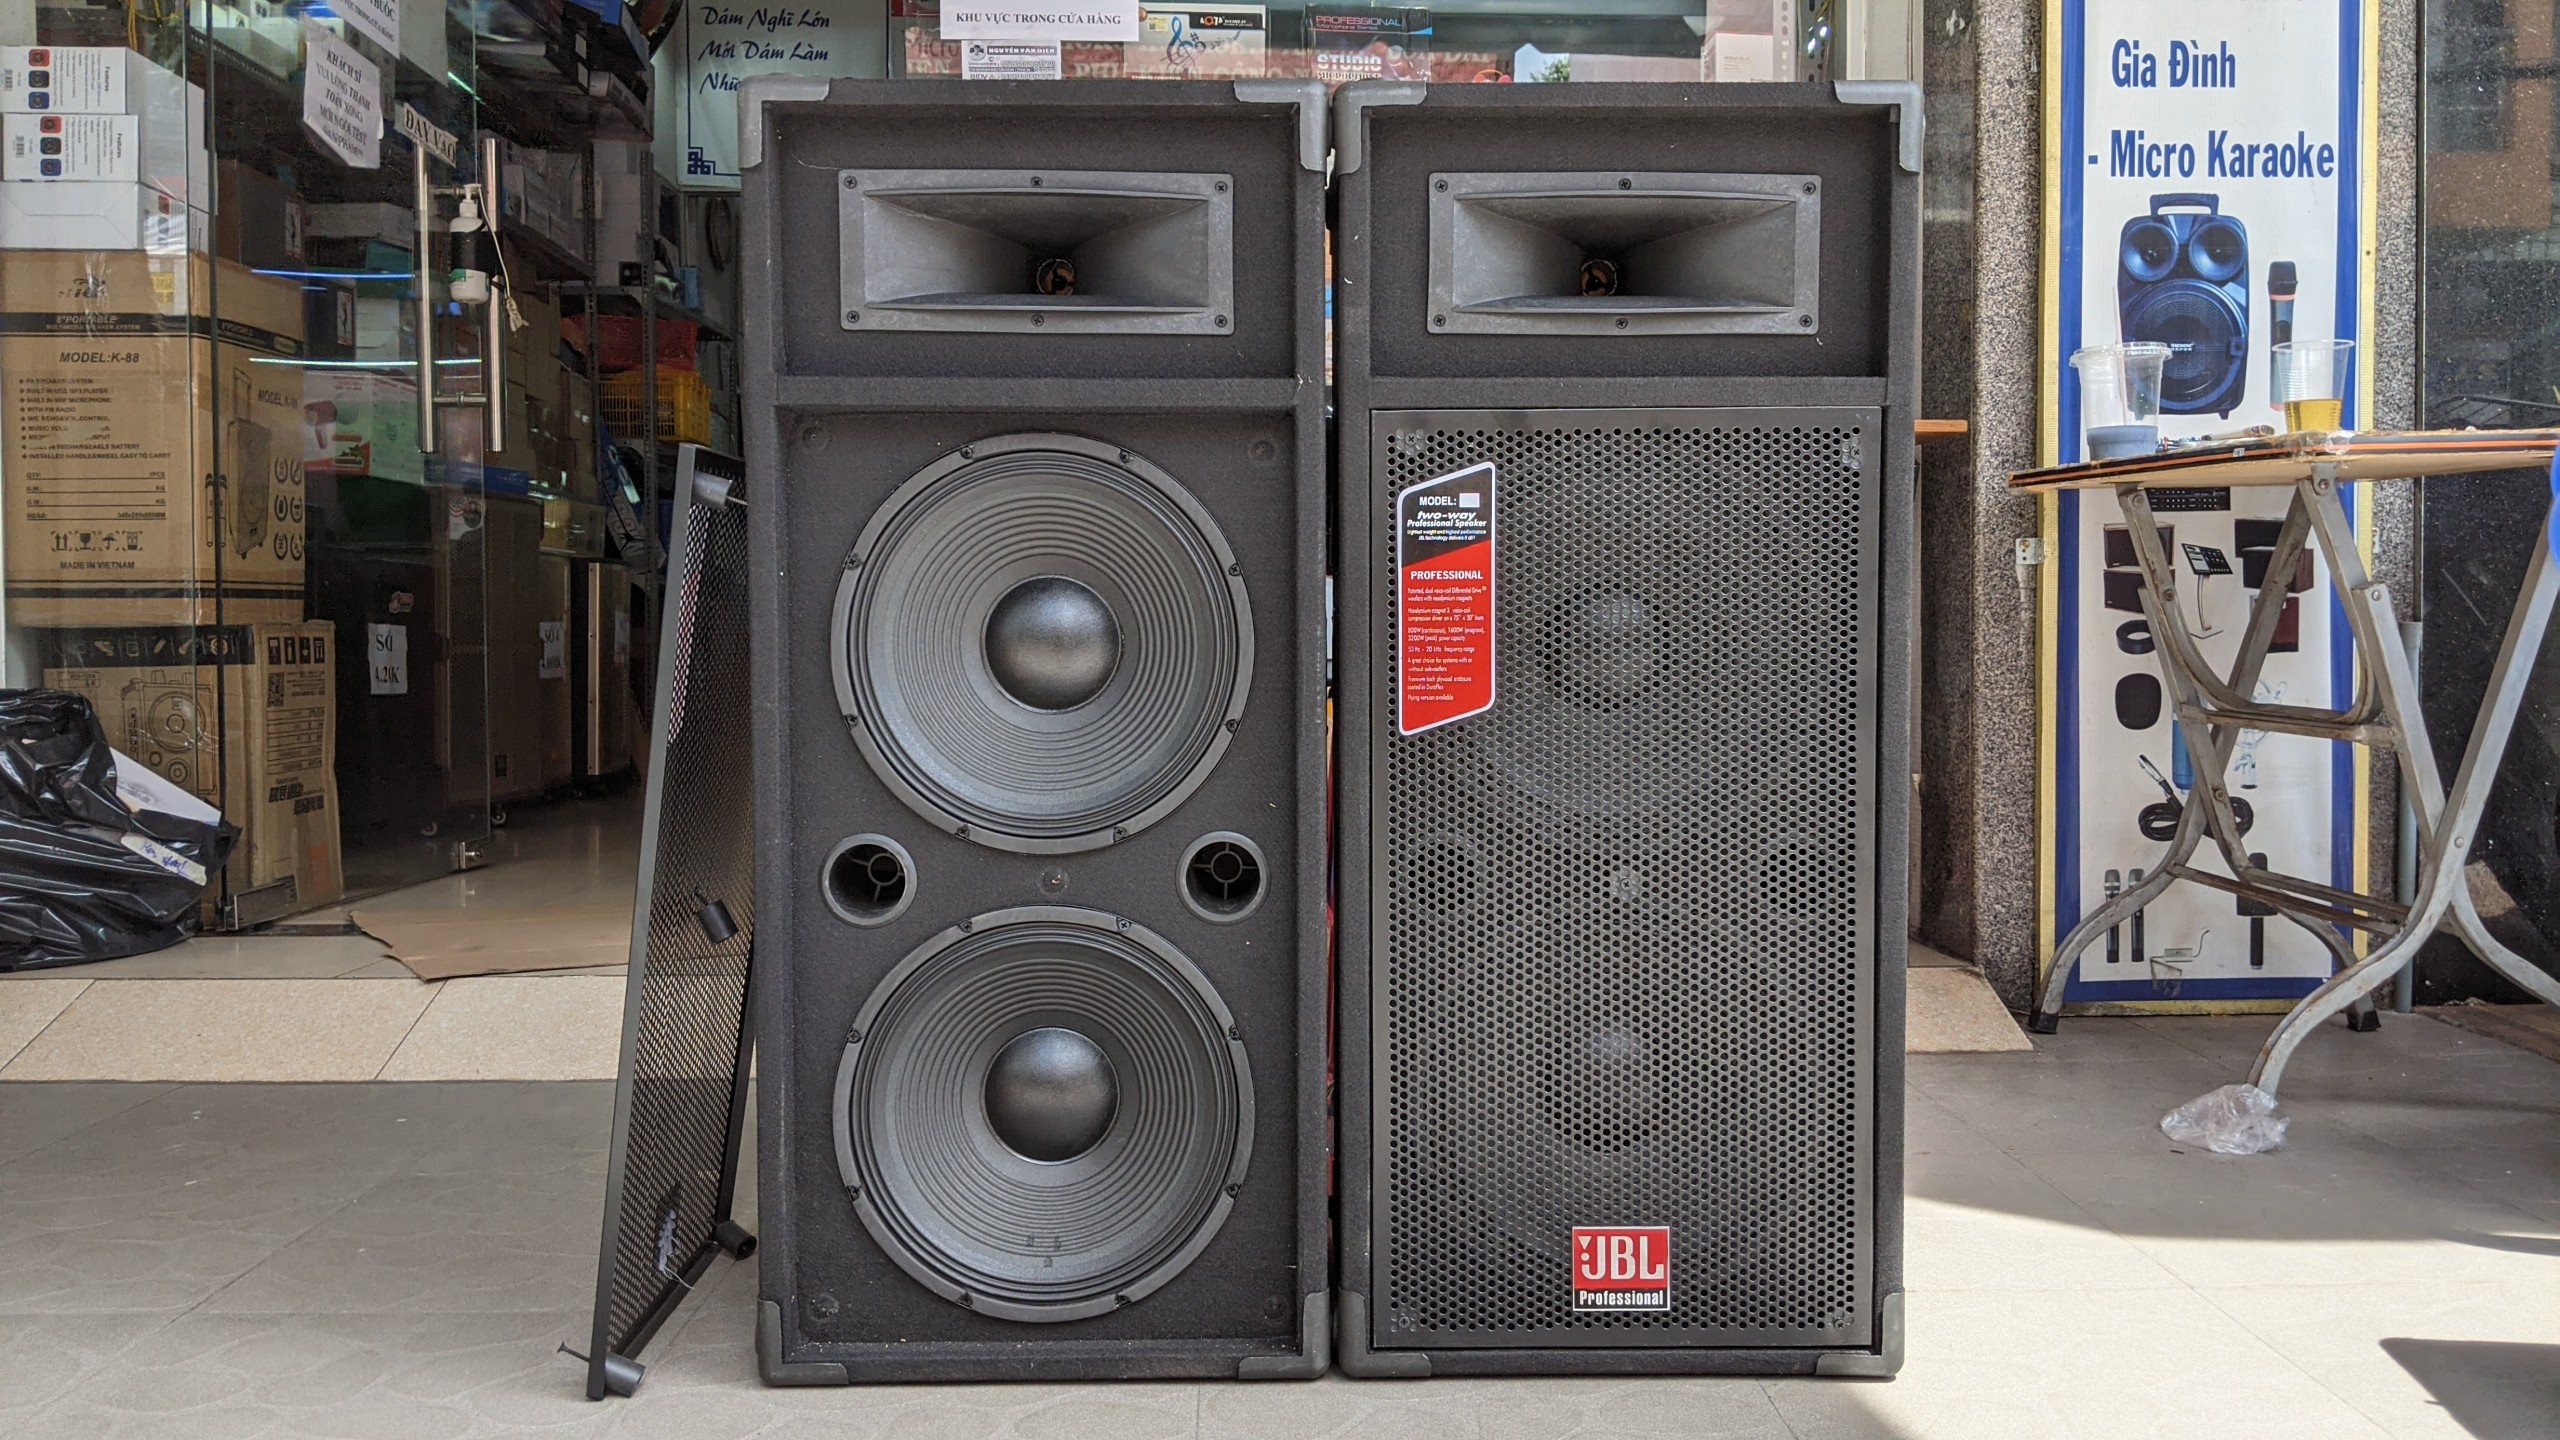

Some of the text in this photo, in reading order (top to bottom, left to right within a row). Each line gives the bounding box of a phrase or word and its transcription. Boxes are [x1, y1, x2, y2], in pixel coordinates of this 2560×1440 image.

[702, 6, 830, 33] Dám Nghĩ Lớn
[956, 12, 1121, 25] KHU VỰC TRONG CỬA HÀNG
[1316, 16, 1401, 26] PROFESSIONAL
[698, 40, 828, 61] Mới Dám Làm
[1317, 54, 1382, 71] STUDIO
[2112, 38, 2236, 88] Gia Đình
[2110, 129, 2195, 178] Micro
[2207, 129, 2335, 178] Karaoke
[59, 352, 140, 363] MODEL:K-88
[1420, 496, 1457, 506] MODEL:
[1417, 511, 1477, 521] two-way
[1407, 519, 1487, 528] Professional Speaker
[1411, 571, 1483, 580] PROFESSIONAL
[1578, 1235, 1664, 1280] JBL
[1579, 1290, 1663, 1305] Professional
